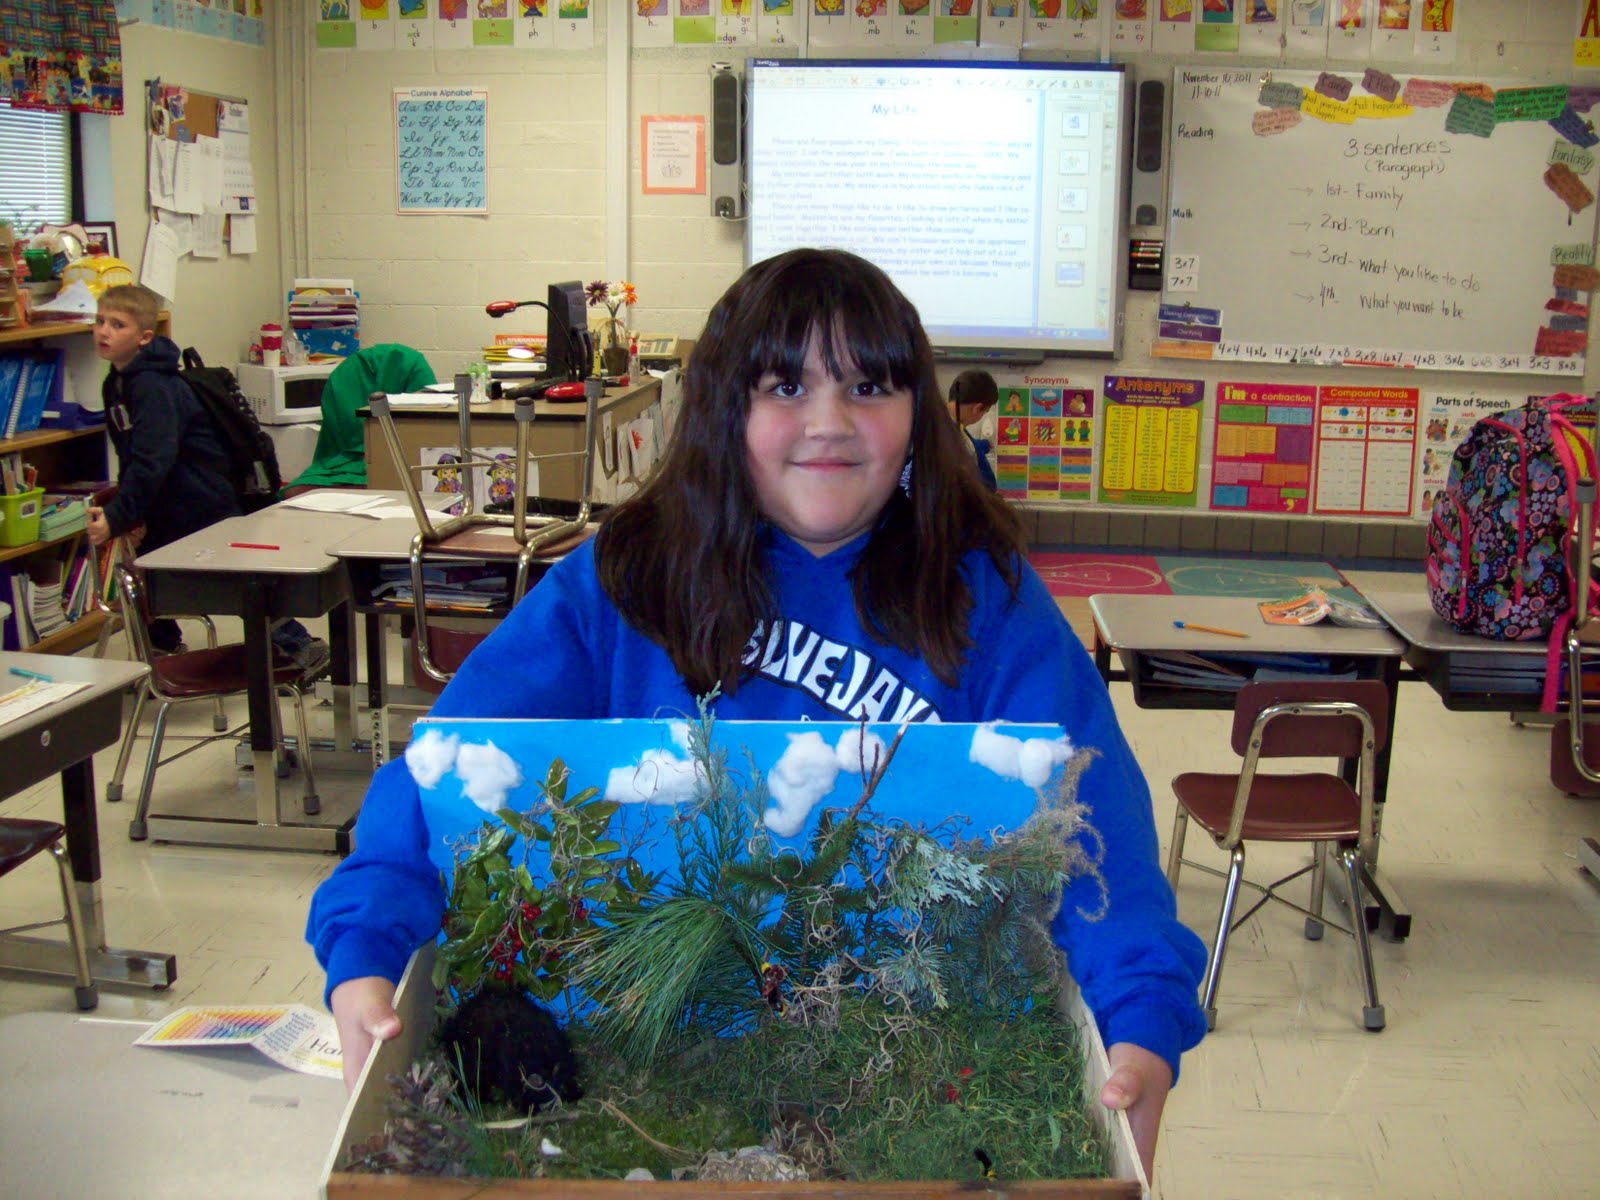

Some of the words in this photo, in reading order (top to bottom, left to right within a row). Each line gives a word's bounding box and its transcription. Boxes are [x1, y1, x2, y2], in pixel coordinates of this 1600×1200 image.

[528, 28, 538, 39] ph
[1183, 72, 1218, 84] November
[1233, 72, 1252, 83] 2011
[440, 89, 473, 97] Alphabet
[872, 103, 890, 118] My
[1177, 123, 1214, 140] Reading
[1344, 138, 1359, 157] 3
[1364, 134, 1451, 156] sentences
[1552, 141, 1593, 170] Fantasy
[1356, 182, 1404, 211] Family
[1172, 208, 1193, 218] Math
[1356, 218, 1395, 238] Born
[1554, 245, 1592, 262] Reality
[1359, 258, 1388, 275] What
[1394, 265, 1414, 282] you
[1417, 264, 1439, 283] like
[1461, 273, 1480, 292] do
[1360, 291, 1389, 309] What
[1394, 299, 1411, 316] you
[1412, 301, 1434, 315] want
[1500, 357, 1520, 369] 3x4
[1558, 360, 1577, 371] 8x8
[1024, 376, 1069, 385] Synonyms
[1115, 377, 1195, 395] Antonyms
[1225, 385, 1246, 401] I'm
[1330, 388, 1380, 398] Compound
[1382, 389, 1409, 399] Words
[1436, 396, 1461, 406] Parts
[1463, 396, 1474, 406] of
[1476, 399, 1511, 409] Speech
